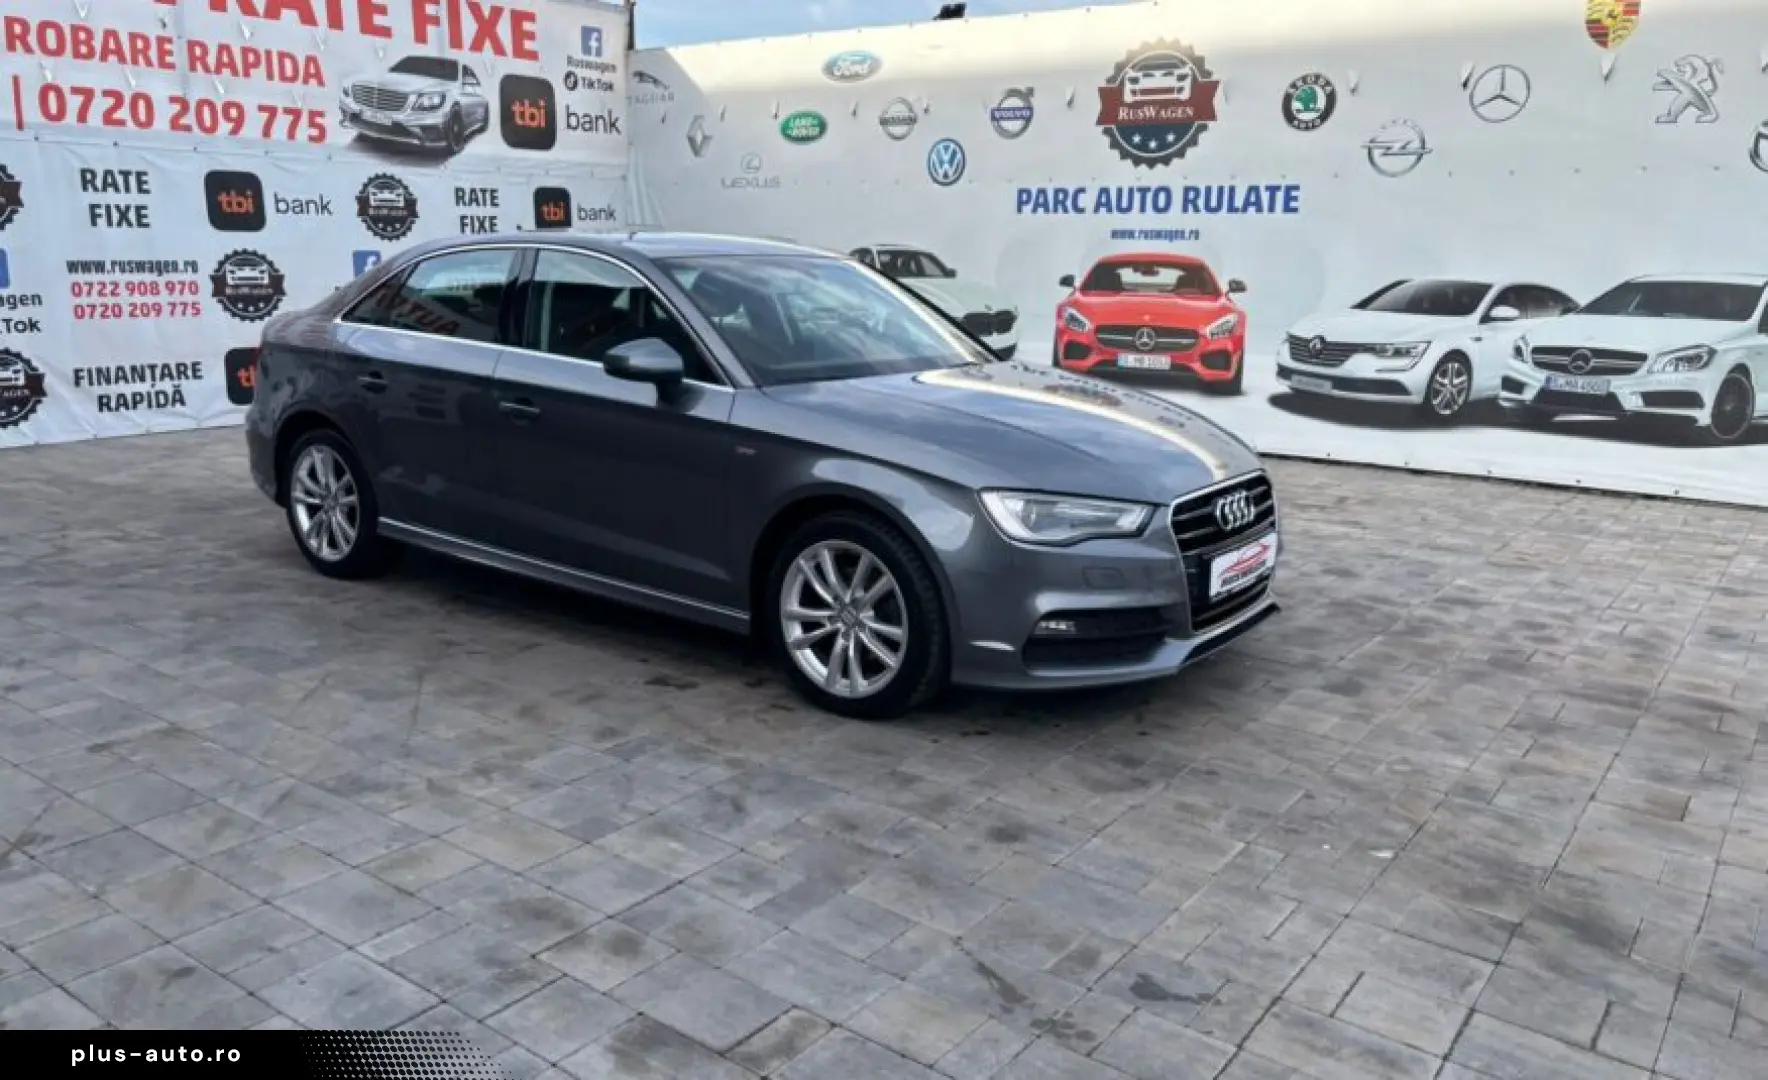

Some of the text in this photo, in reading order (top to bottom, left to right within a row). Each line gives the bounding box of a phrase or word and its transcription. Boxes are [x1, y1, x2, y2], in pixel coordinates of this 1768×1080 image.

[411, 0, 540, 61] FIXE
[4, 15, 326, 87] ROBARE RAPIDA
[38, 82, 155, 130] 0720
[168, 95, 245, 136] 209
[257, 104, 327, 144] 775
[511, 98, 546, 128] tbi
[565, 103, 622, 135] bank
[80, 167, 151, 195] RATE
[218, 190, 255, 214] tbi
[274, 192, 333, 216] bank
[455, 186, 500, 208] RATE
[1015, 184, 1301, 215] PARC AUTO RULATE
[89, 203, 151, 229] FIXE
[541, 202, 564, 222] tbi
[577, 203, 616, 222] bank
[459, 215, 498, 235] FIXE
[66, 258, 200, 277] www.ruswagen.ro
[71, 279, 200, 299] 0722 908 970
[73, 301, 202, 321] 0720 209 775
[97, 384, 186, 414] RAPIDĂ
